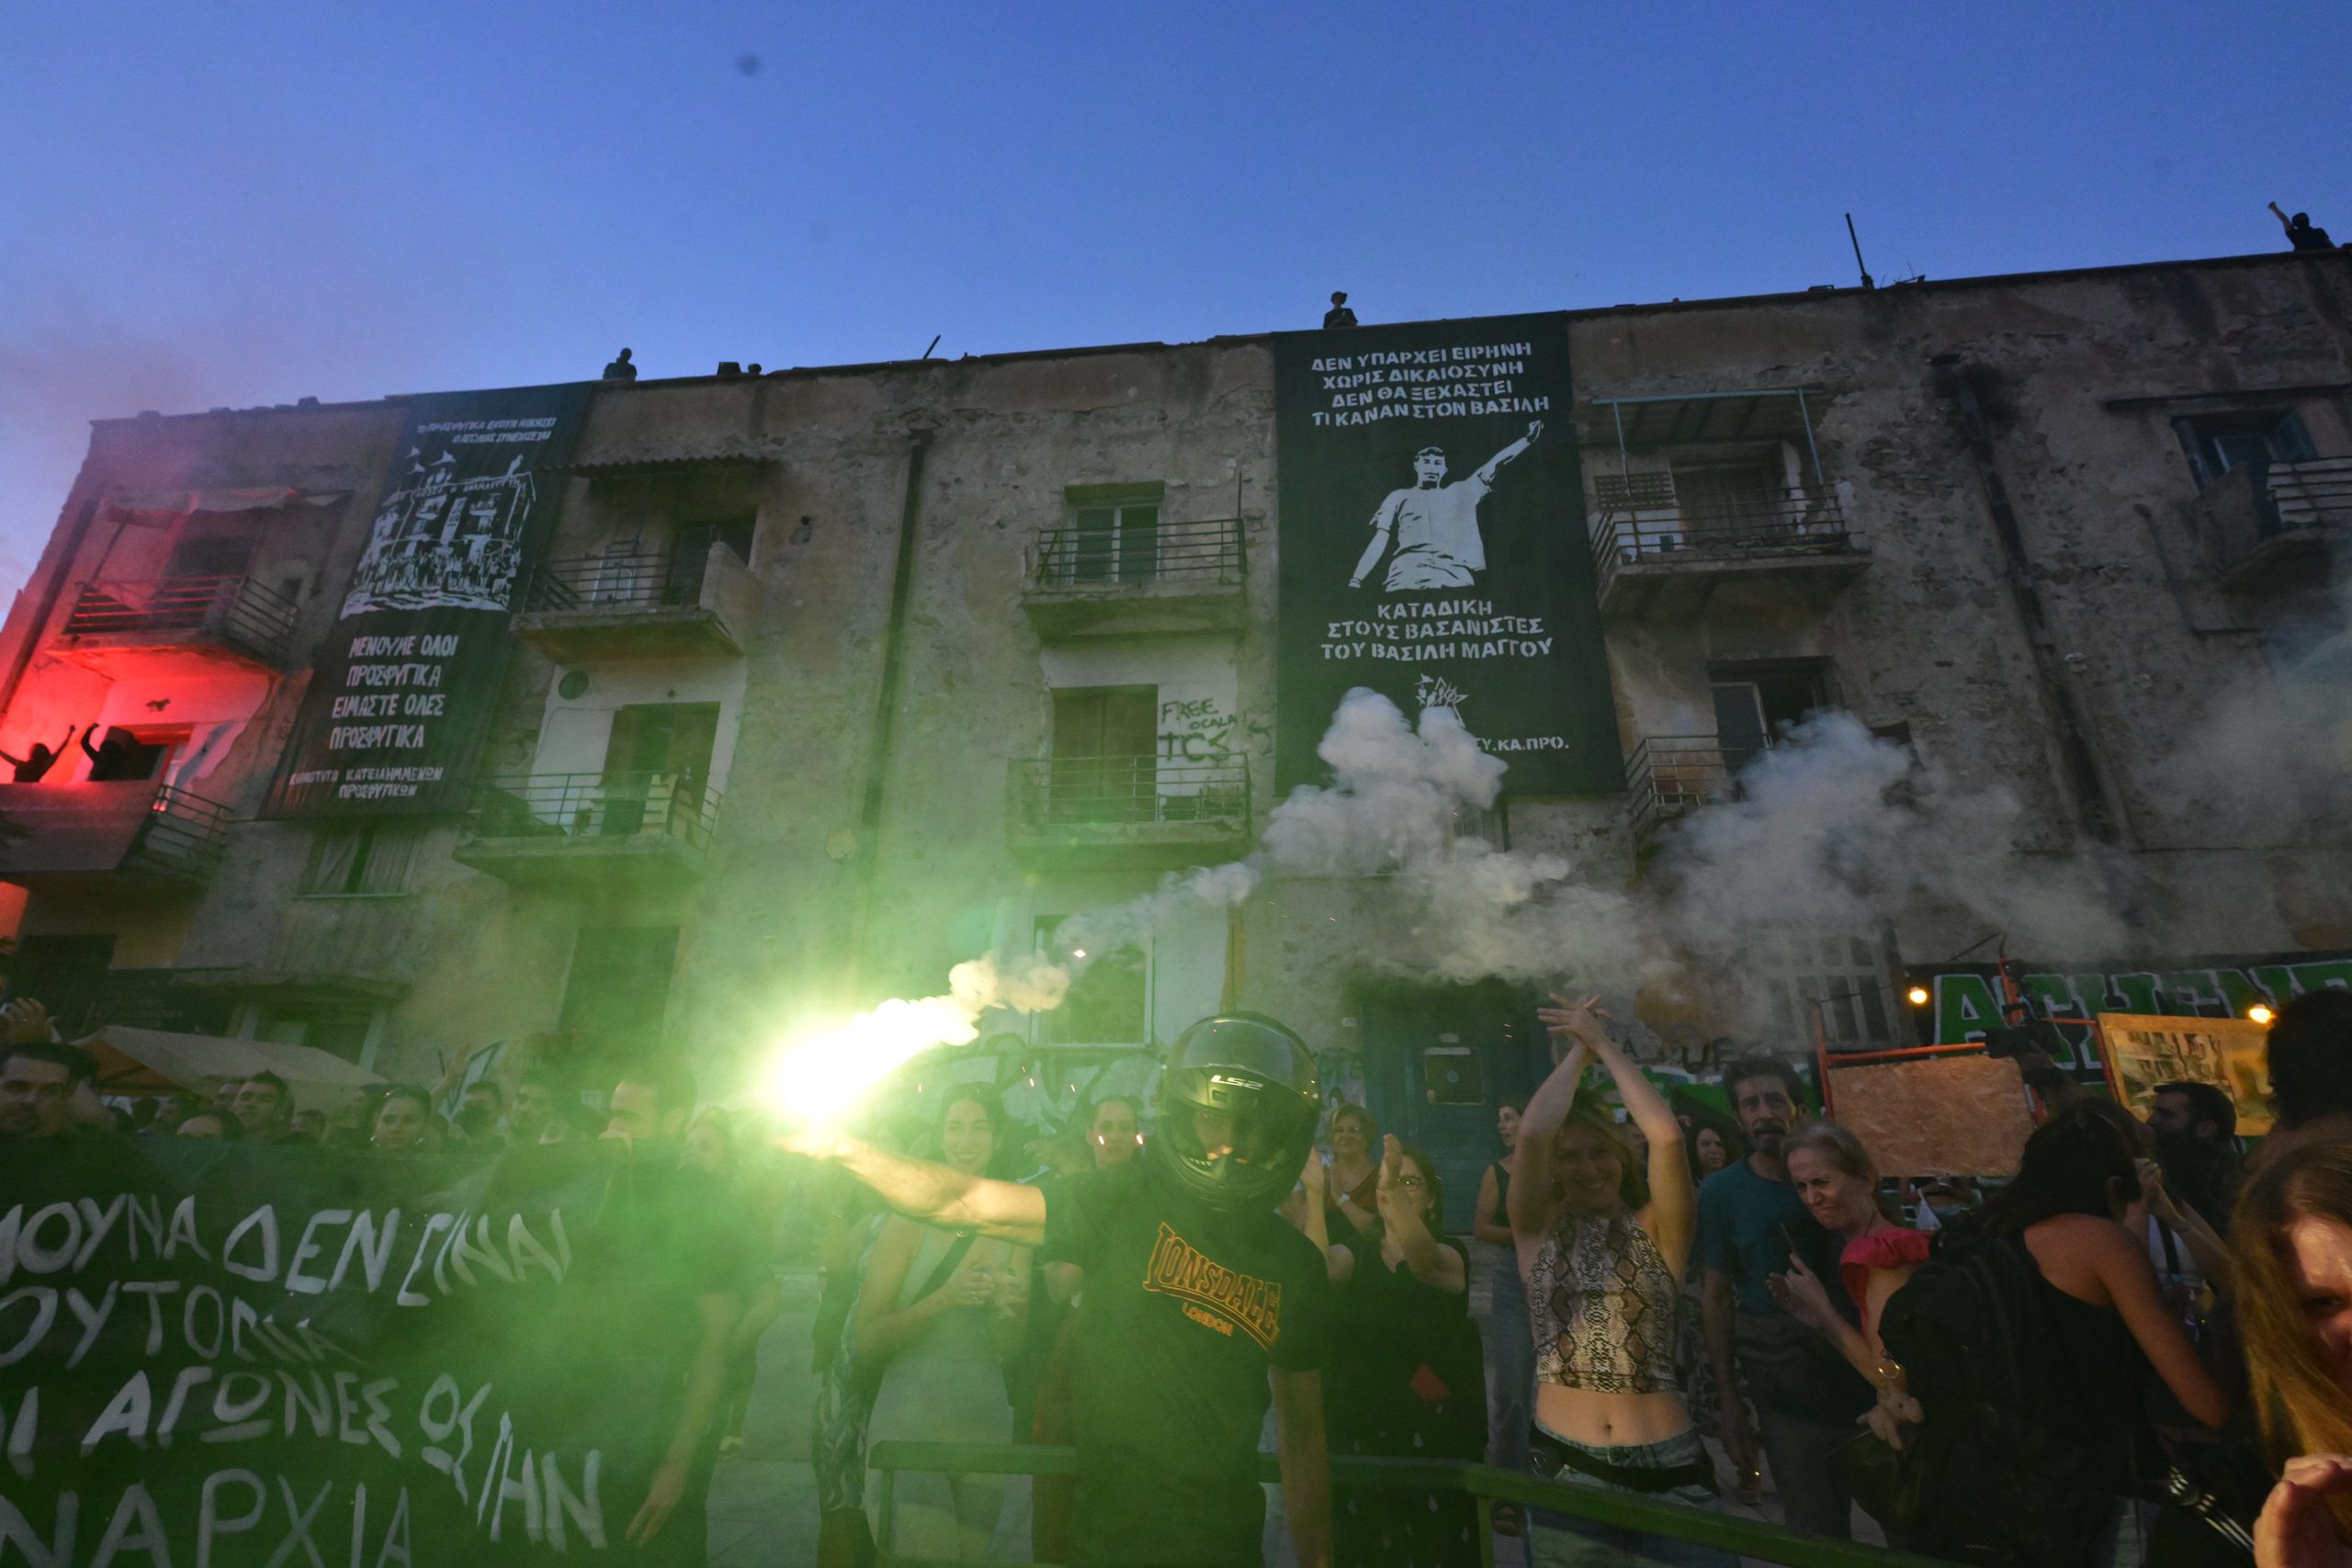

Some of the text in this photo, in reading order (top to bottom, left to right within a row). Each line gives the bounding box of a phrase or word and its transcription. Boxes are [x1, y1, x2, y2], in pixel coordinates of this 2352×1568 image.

[1311, 342, 1532, 372] ΔΕΝ ΥΠΑΡΧΕΙ ΕΙΡΗΝΗ
[1323, 361, 1524, 389] ΧΩΡΙΣ ΔΙΚΑΙΟΣΥΝΗ
[1331, 379, 1513, 408] ΔΕΝ ΘΑ ΞΕΧΑΣΤΕΙ
[1312, 396, 1550, 427] ΤΙ ΚΑΝΑΝ ΣΤΟΝ ΒΑΣΙΛΗ
[1377, 600, 1492, 620] ΚΑΤΑΔΙΚΗ
[1328, 616, 1544, 640] ΣΤΟΥΣ ΒΑΣΑΝΙΣΤΕΣ
[420, 634, 459, 657] ΟΛΟΙ
[1321, 637, 1553, 661] ΤΟΥ ΒΑΣΙΛΗ ΜΑΓΓΟΥ
[345, 663, 442, 687] ΠΡΟΣΦΥΓΙΚΑ
[332, 694, 446, 718] ΕΙΜΑΣΤΕ ΟΛΕΣ
[1161, 698, 1219, 725] FREE
[329, 725, 424, 750] ΠΡΟΣΦΥΓΙΚΑ
[1210, 1075, 1264, 1091] LS2
[223, 1203, 401, 1294] ΔΕΝ
